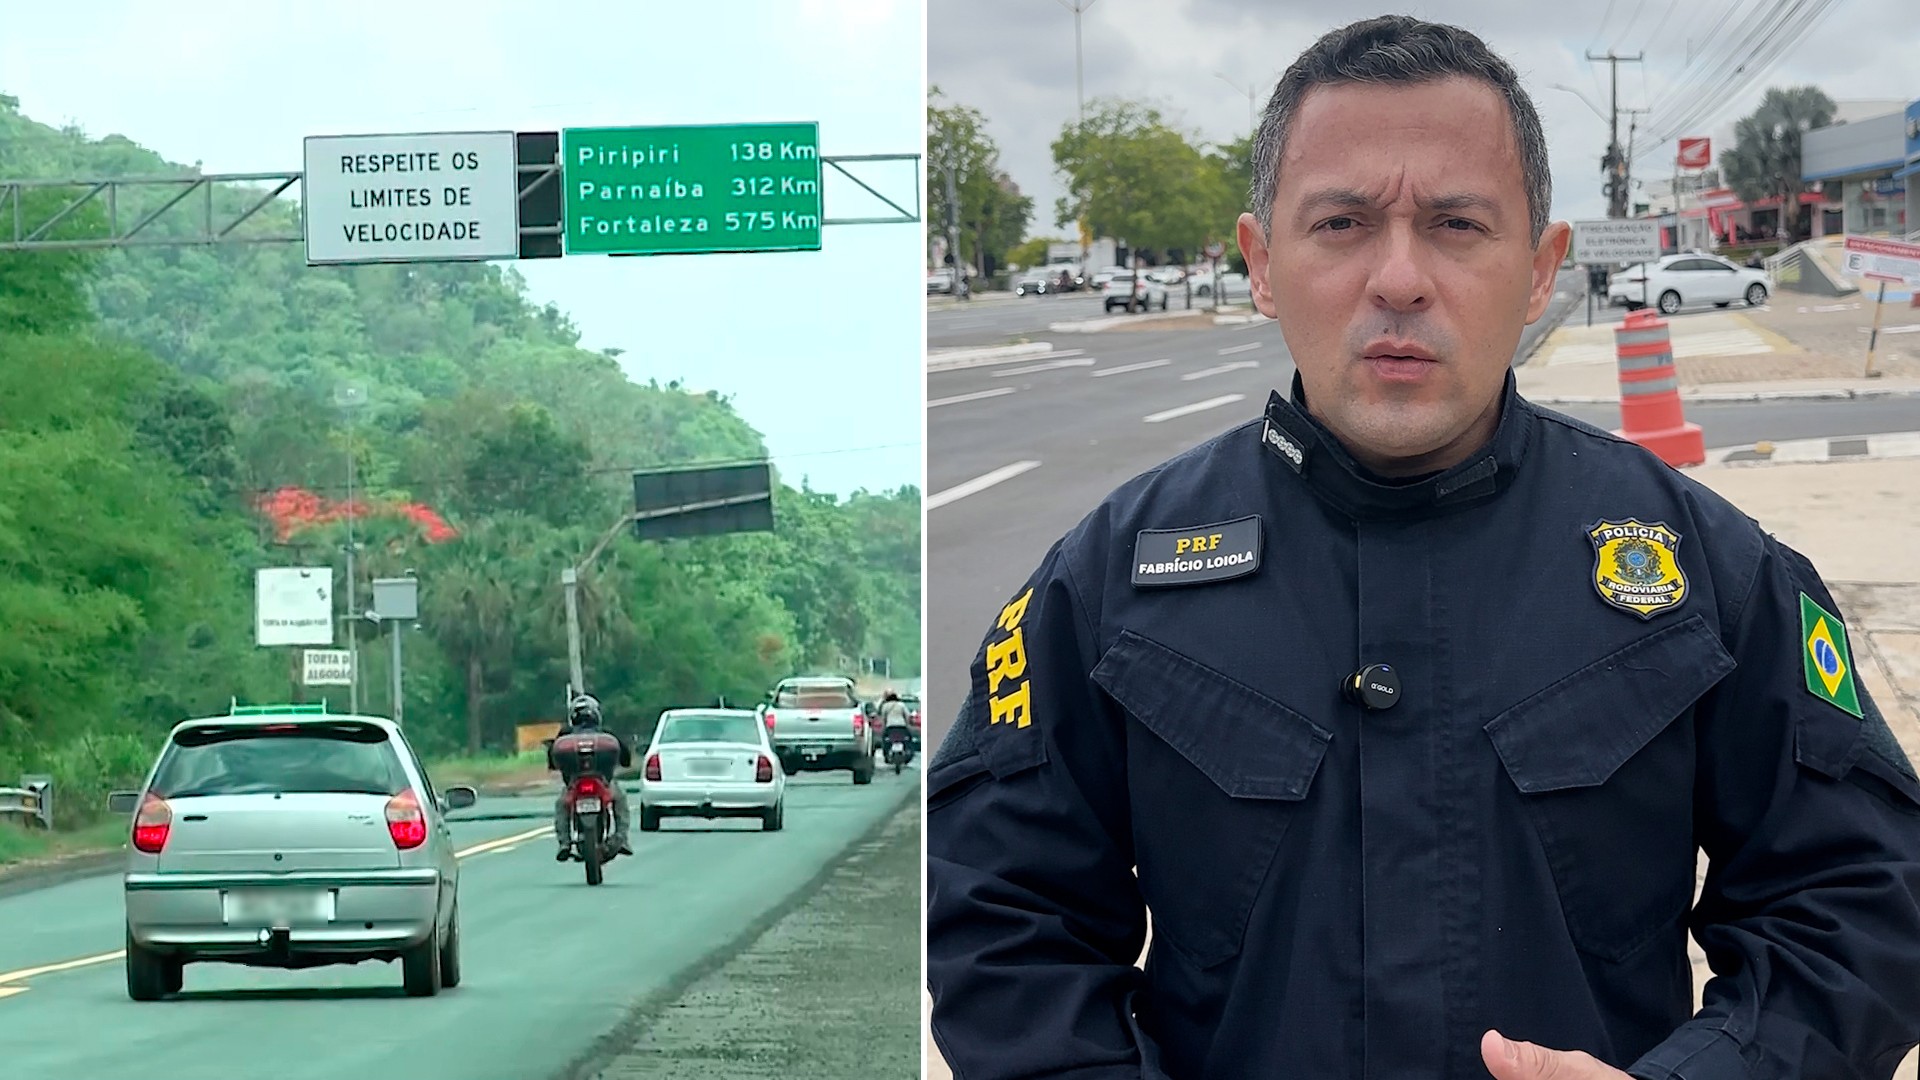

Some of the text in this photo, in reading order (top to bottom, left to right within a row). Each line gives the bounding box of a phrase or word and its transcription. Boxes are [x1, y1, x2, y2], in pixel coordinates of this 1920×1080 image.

[341, 152, 479, 173] RESPEITE OS
[578, 141, 816, 166] Piripiri 138 Km
[350, 187, 471, 209] LIMITES DE
[580, 177, 817, 200] Parnaíba 312 Km
[343, 221, 481, 243] VELOCIDADE
[581, 212, 818, 235] Fortaleza 575 Km
[1176, 534, 1222, 554] PRF
[1139, 551, 1253, 574] FABRÍCIO LOIOLA
[1620, 595, 1668, 604] FEDERAL
[308, 654, 339, 664] TORTA
[987, 588, 1033, 729] PRF
